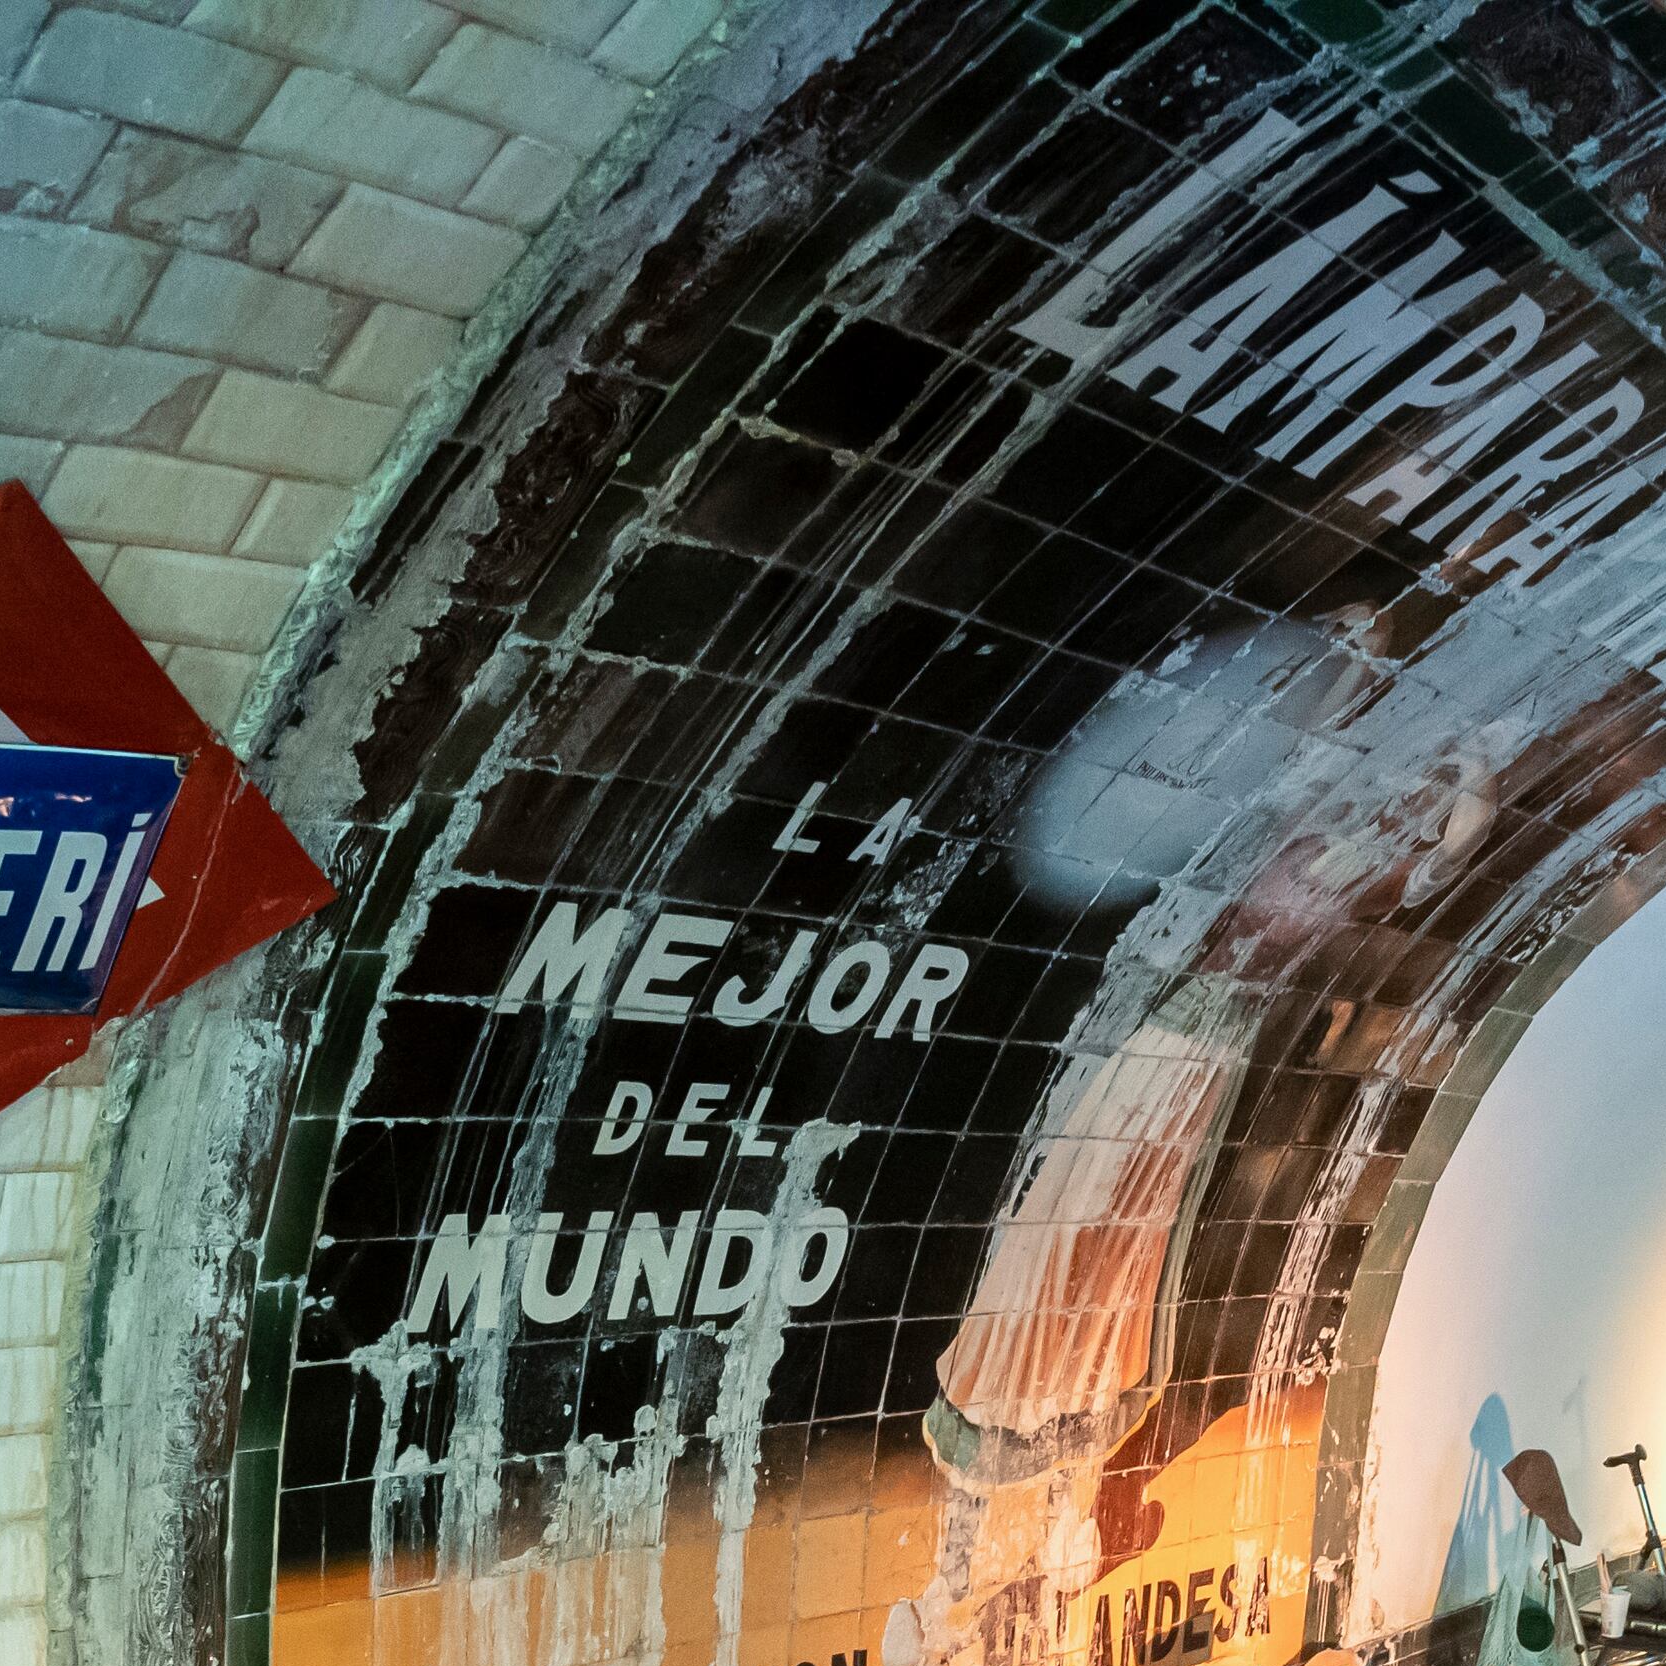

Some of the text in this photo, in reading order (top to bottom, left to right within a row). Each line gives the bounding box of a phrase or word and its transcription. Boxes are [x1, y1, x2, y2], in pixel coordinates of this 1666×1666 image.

[773, 781, 915, 866] LA
[493, 900, 971, 1044] MEJOR
[593, 1080, 783, 1158] DEL
[406, 1206, 850, 1335] MUNDO
